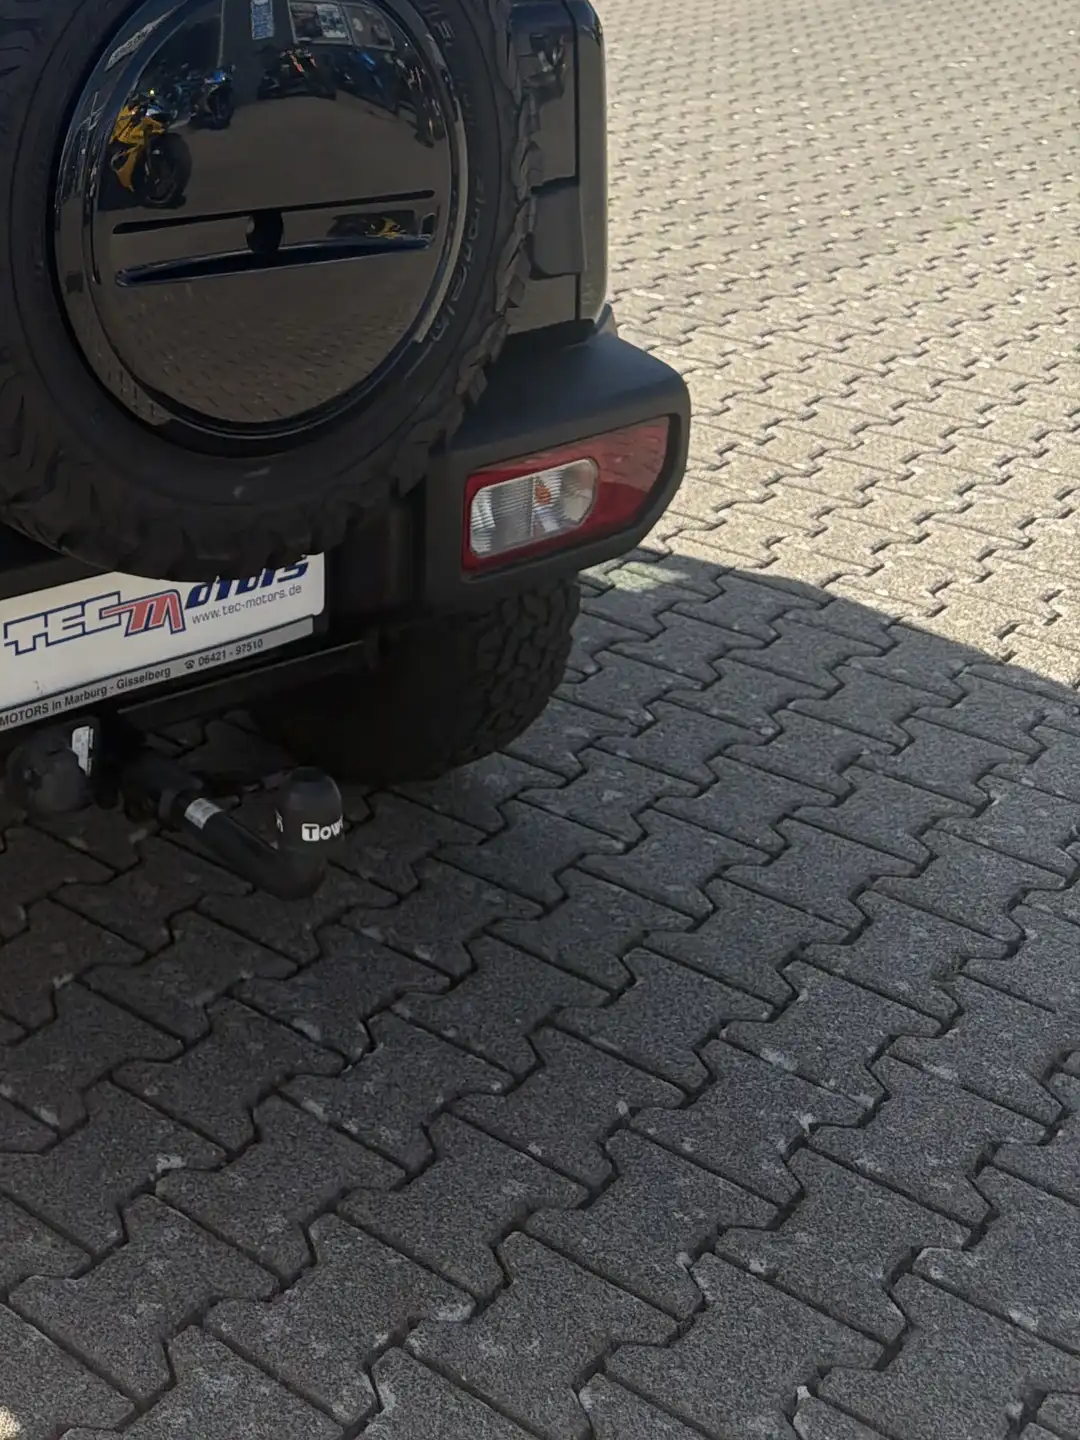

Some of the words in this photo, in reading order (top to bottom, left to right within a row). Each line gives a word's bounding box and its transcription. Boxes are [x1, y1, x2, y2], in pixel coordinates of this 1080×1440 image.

[191, 583, 303, 625] www.tec-motors.de
[0, 702, 50, 729] MOTORS
[51, 698, 63, 711] in
[64, 684, 109, 708] Marburg
[116, 666, 172, 691] Gisselberg
